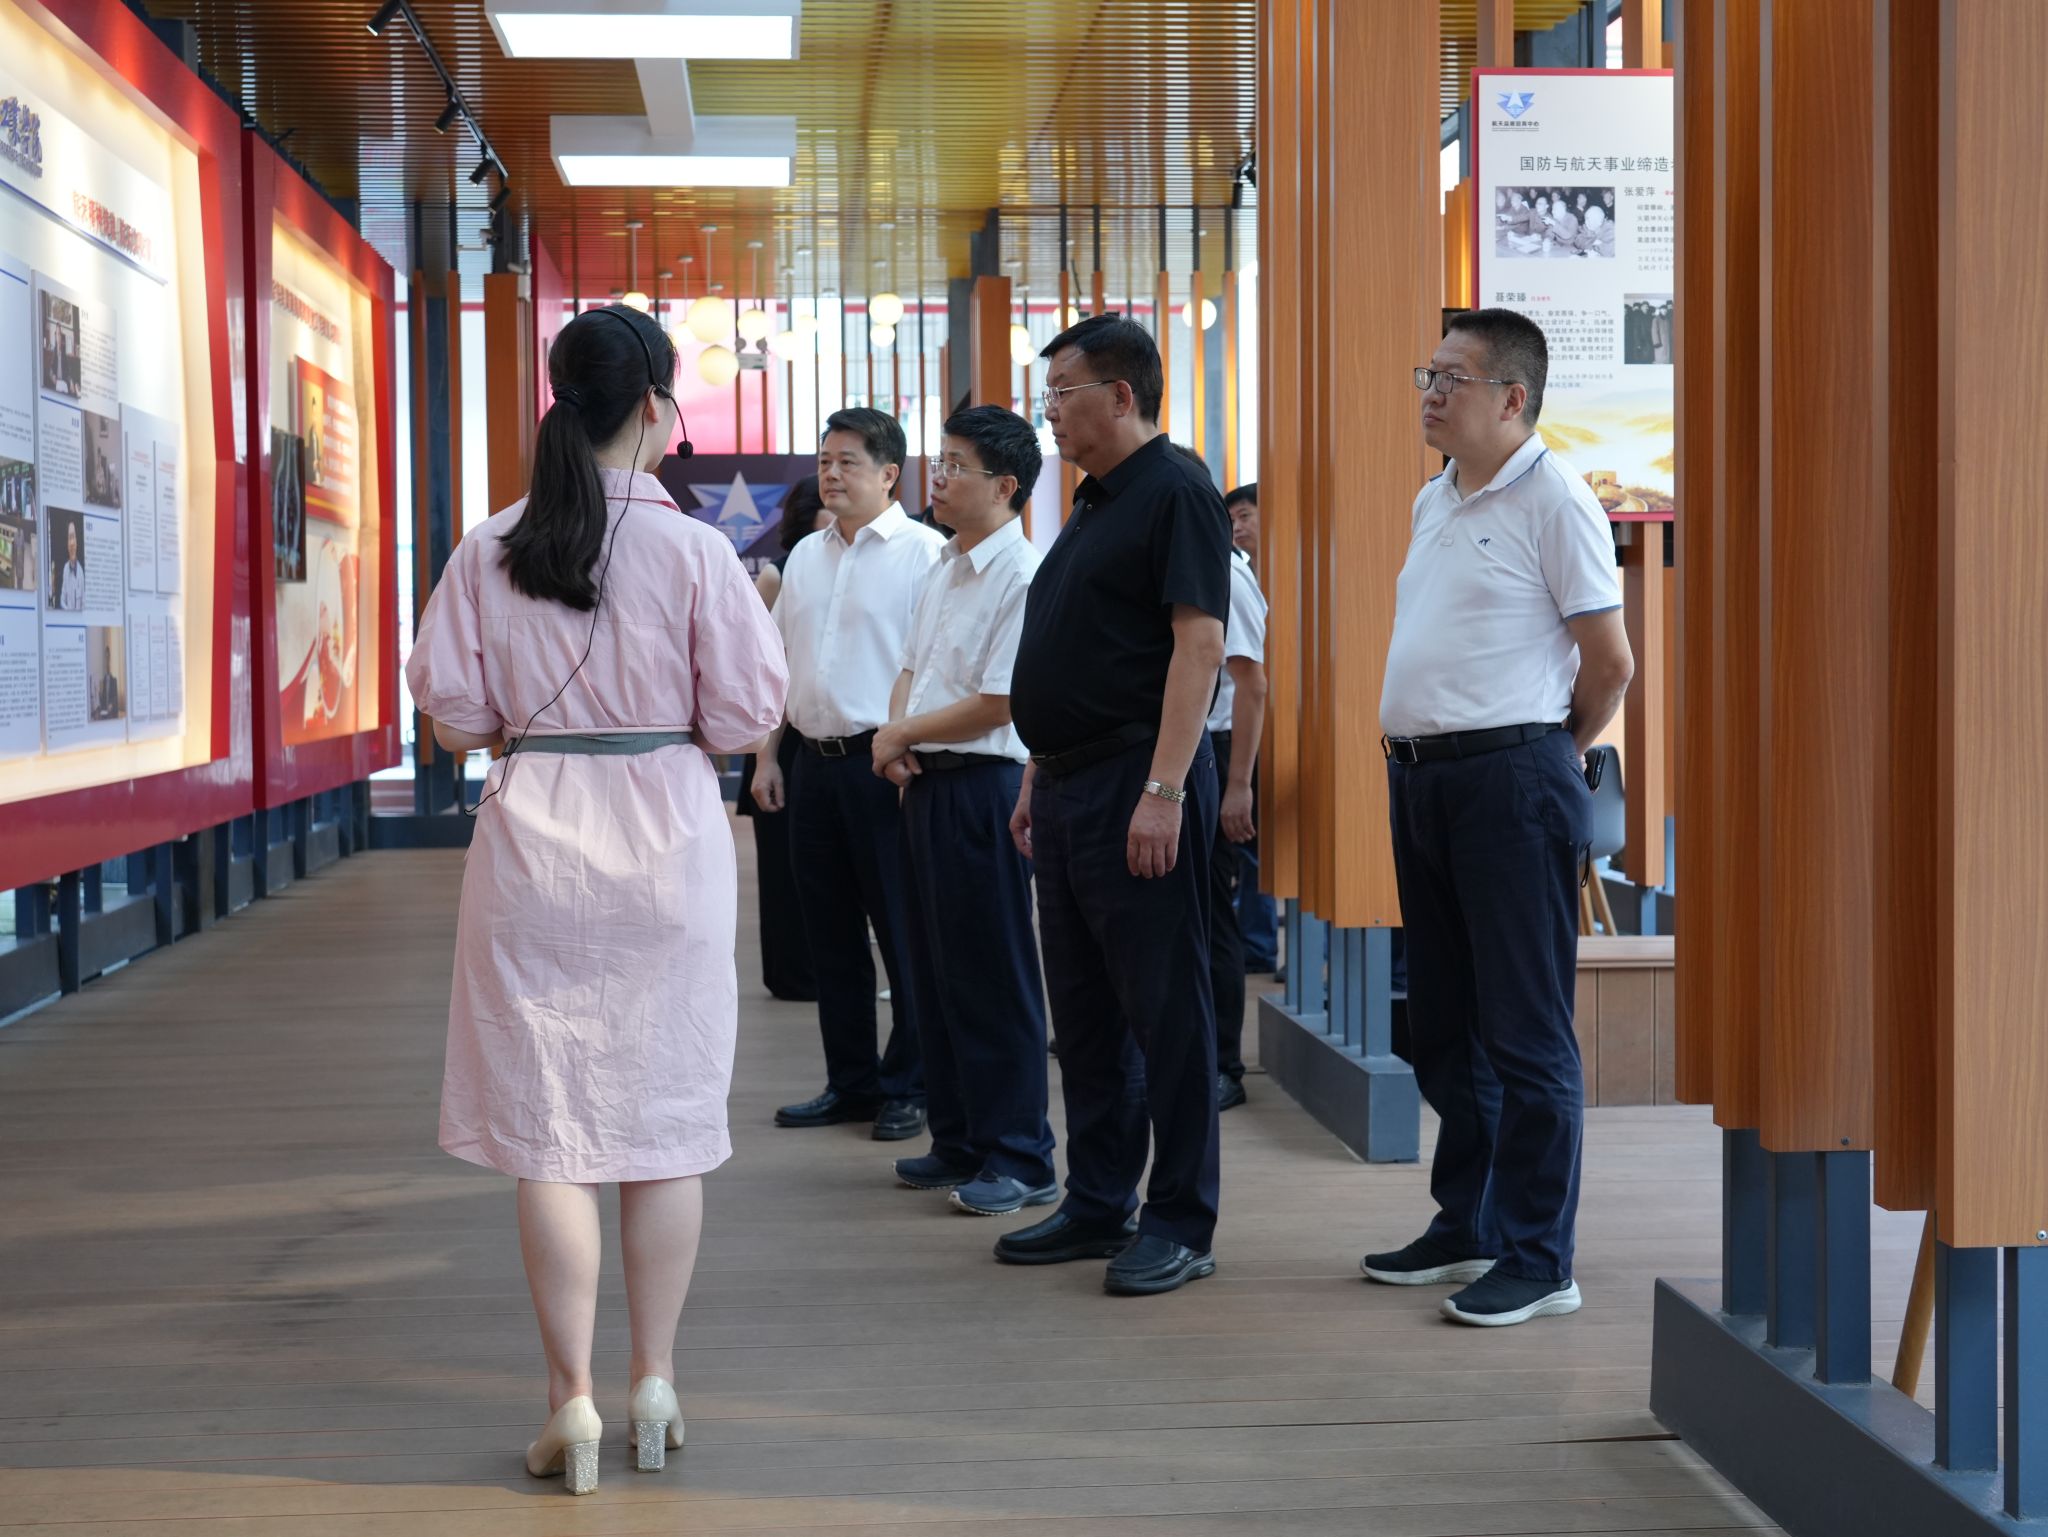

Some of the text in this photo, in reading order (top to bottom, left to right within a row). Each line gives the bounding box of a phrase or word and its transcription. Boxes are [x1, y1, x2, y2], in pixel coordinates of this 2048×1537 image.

[1520, 156, 1674, 172] 国防与航天事业缔造
[1624, 186, 1656, 197] 张爱萍
